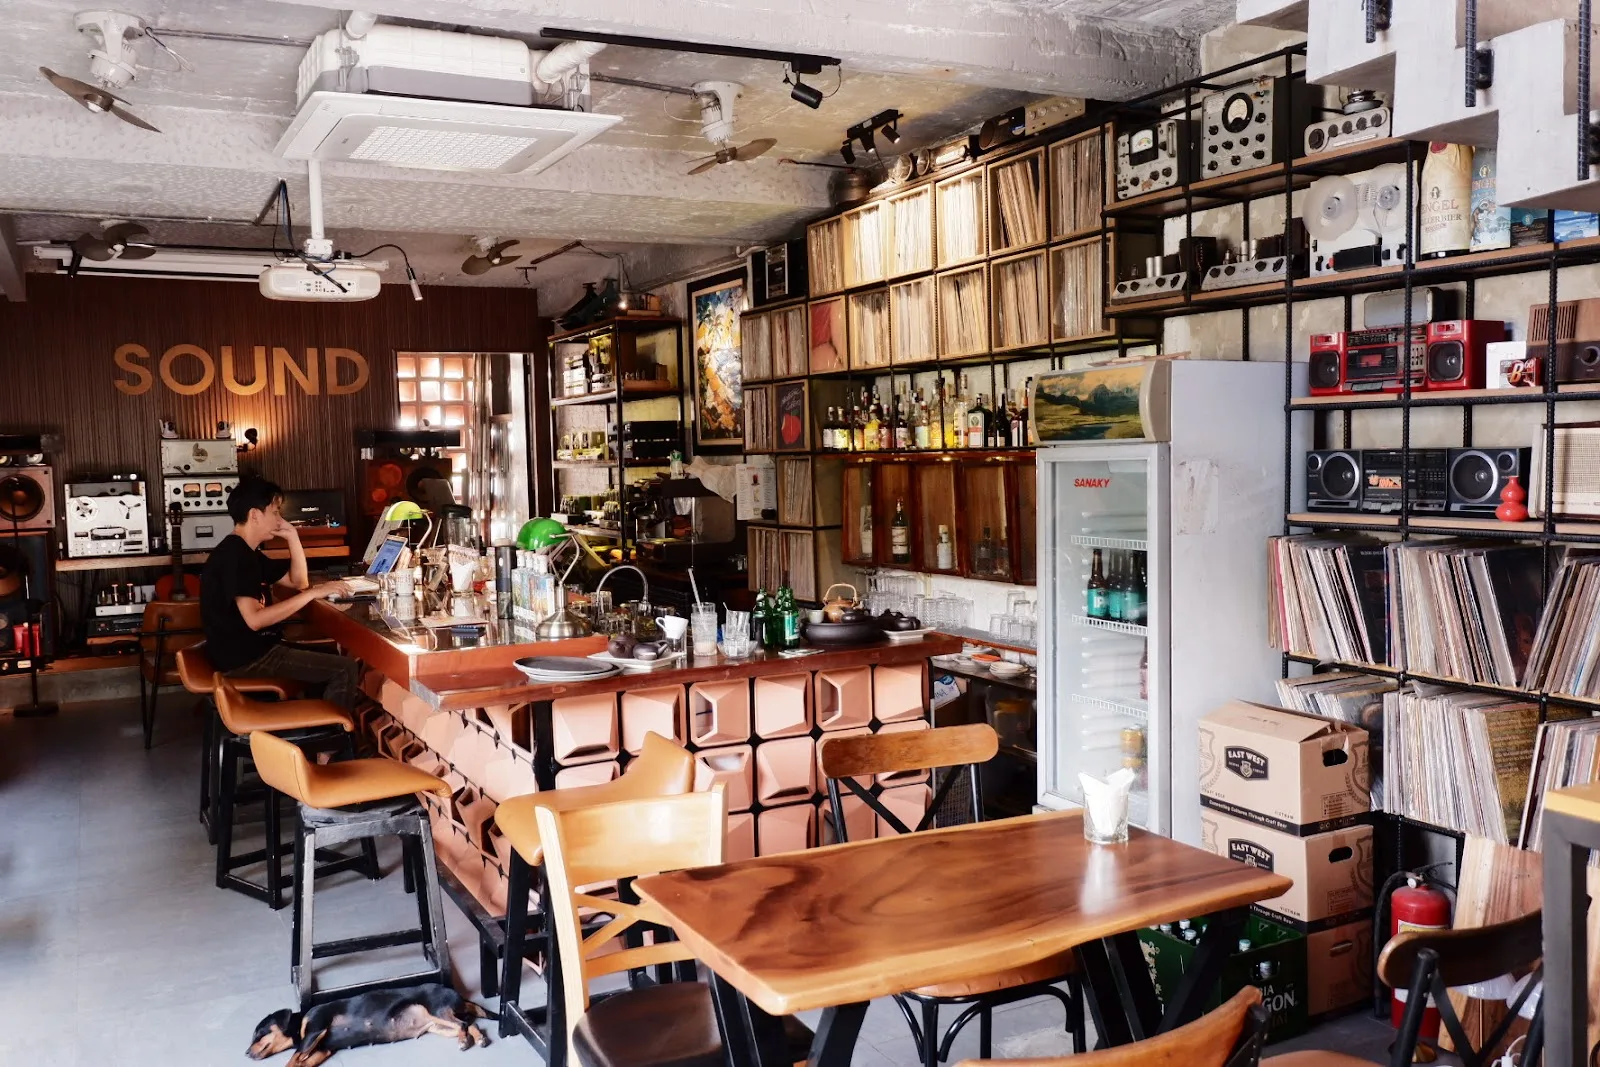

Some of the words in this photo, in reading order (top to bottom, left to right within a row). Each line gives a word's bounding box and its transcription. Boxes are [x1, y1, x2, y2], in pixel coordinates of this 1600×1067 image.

[114, 343, 370, 396] SOUND
[1074, 478, 1110, 488] SANAKY
[1227, 750, 1245, 759] EAST
[1246, 752, 1265, 766] WEST
[1209, 799, 1231, 812] Connecting
[1231, 806, 1248, 817] Cultures
[1248, 811, 1265, 822] Through
[1265, 817, 1277, 827] Craft
[1277, 820, 1288, 829] Beer
[1231, 842, 1249, 852] EAST
[1250, 845, 1271, 862] WEST
[1253, 906, 1271, 917] Through
[1271, 912, 1283, 921] Craft
[1283, 916, 1294, 925] Beer
[1262, 990, 1295, 1013] GON
